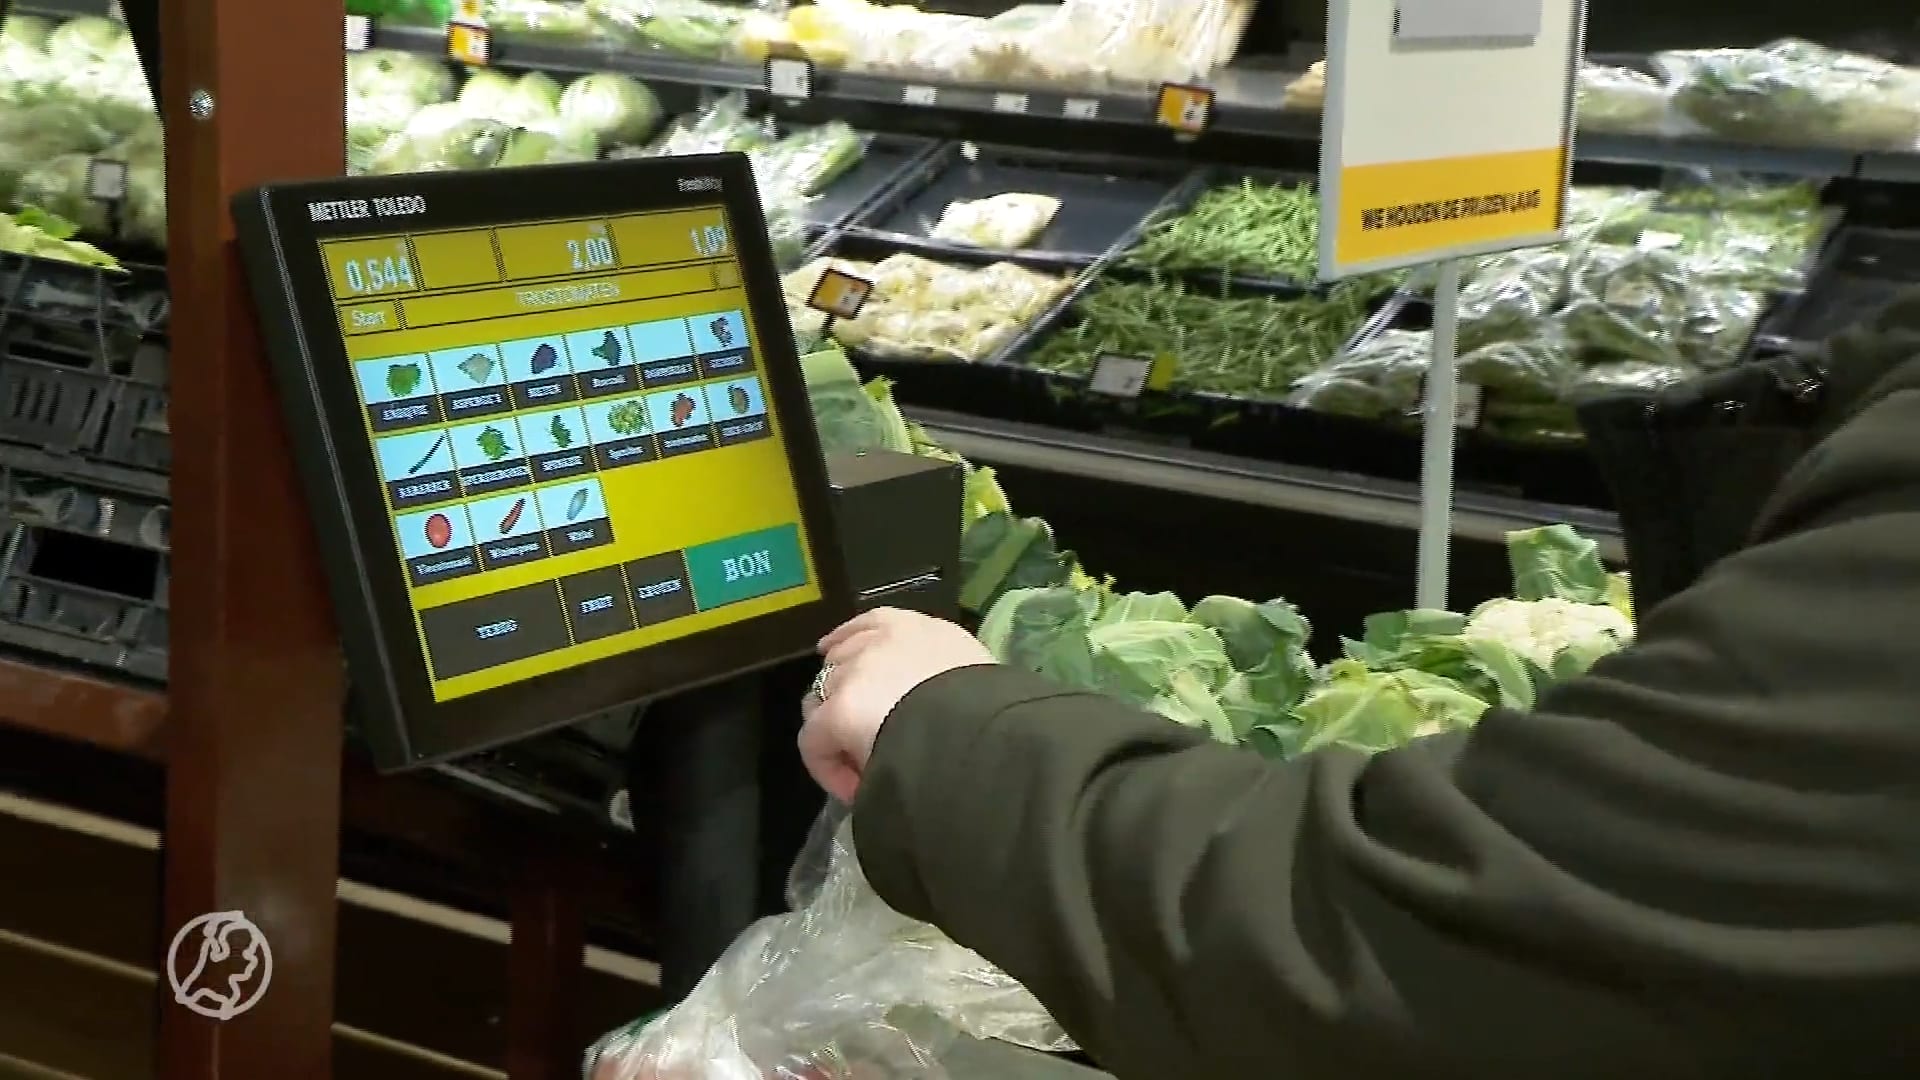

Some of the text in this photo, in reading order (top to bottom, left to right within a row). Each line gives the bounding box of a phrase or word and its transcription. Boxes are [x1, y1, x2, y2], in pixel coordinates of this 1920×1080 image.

[308, 196, 426, 221] METTLER TOLEDO
[1361, 188, 1540, 231] WE HOUDEN DE PRIJZEN LAAG
[690, 226, 727, 256] 1,09
[567, 237, 613, 270] 2,00
[346, 257, 413, 292] 0,544
[517, 282, 619, 305] TROSTOMATEN
[542, 455, 584, 471] SPINAZIE
[398, 480, 451, 498] RABARBER
[722, 549, 772, 582] BON
[638, 578, 682, 599] EXOTEN
[580, 595, 613, 615] FRUIT
[476, 619, 518, 639] TERUG
